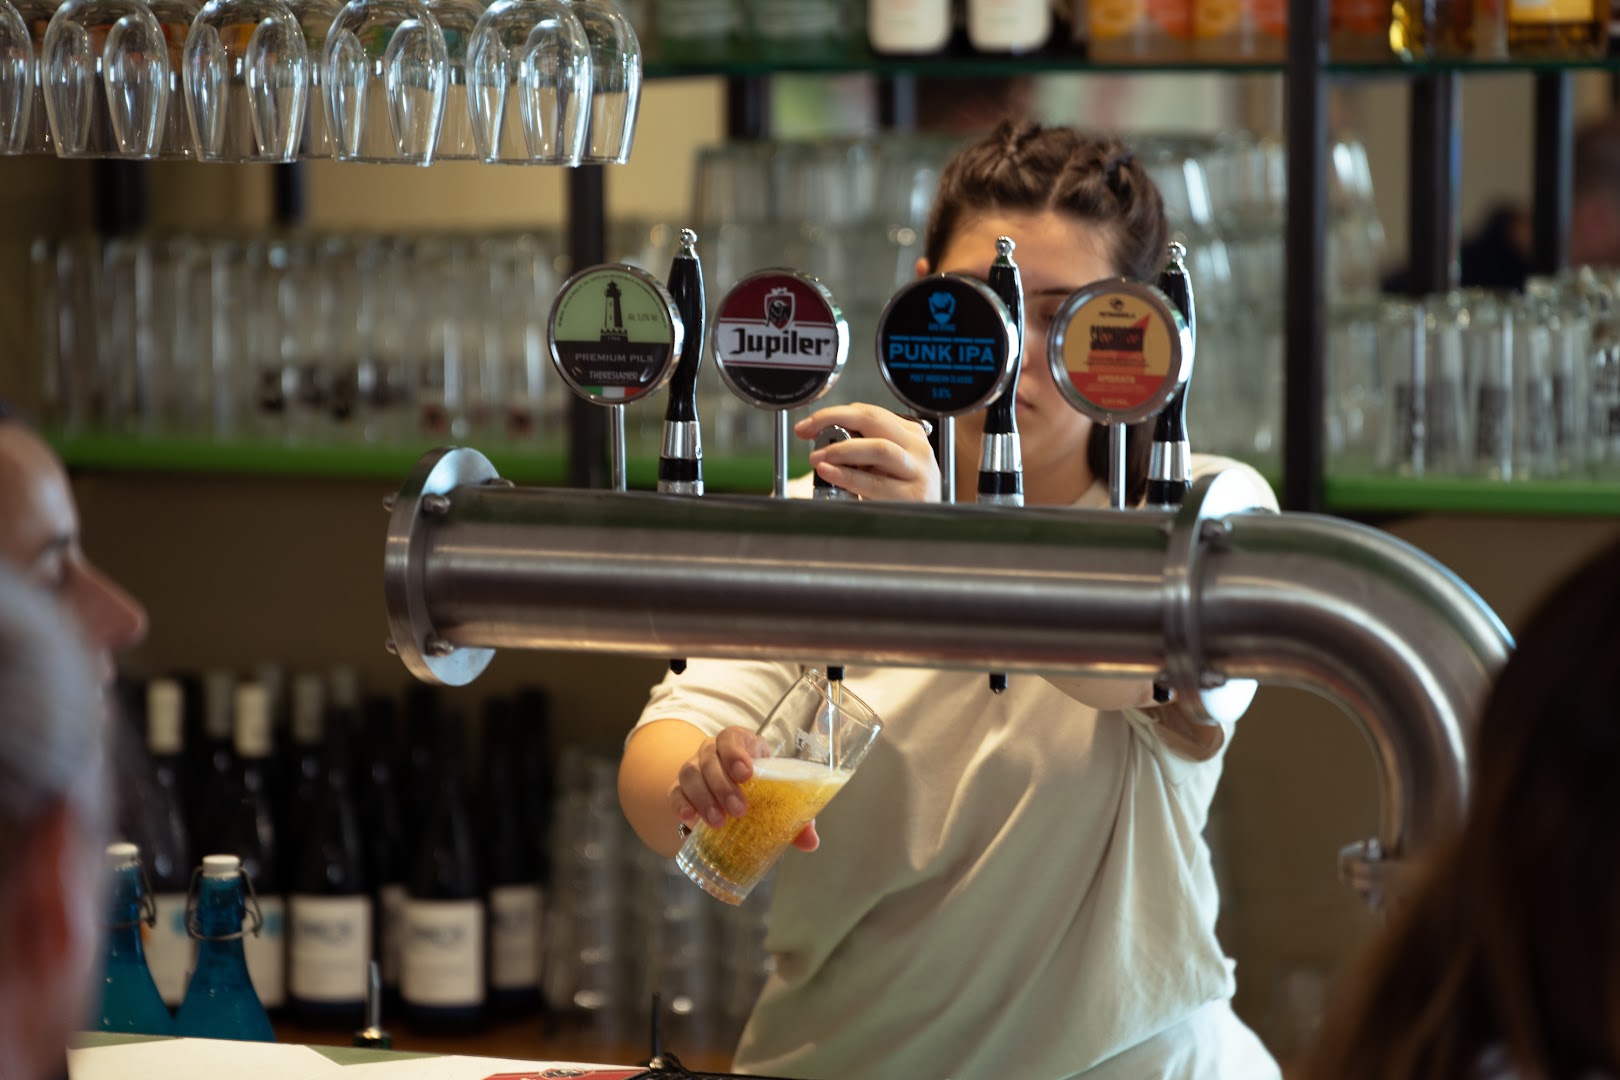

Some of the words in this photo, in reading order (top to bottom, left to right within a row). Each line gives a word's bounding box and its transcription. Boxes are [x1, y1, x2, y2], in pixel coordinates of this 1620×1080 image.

[730, 328, 831, 360] Jupiler
[889, 343, 952, 362] PUNK
[958, 345, 994, 364] IPA
[575, 353, 627, 362] PREMIUM
[629, 354, 655, 363] PILS
